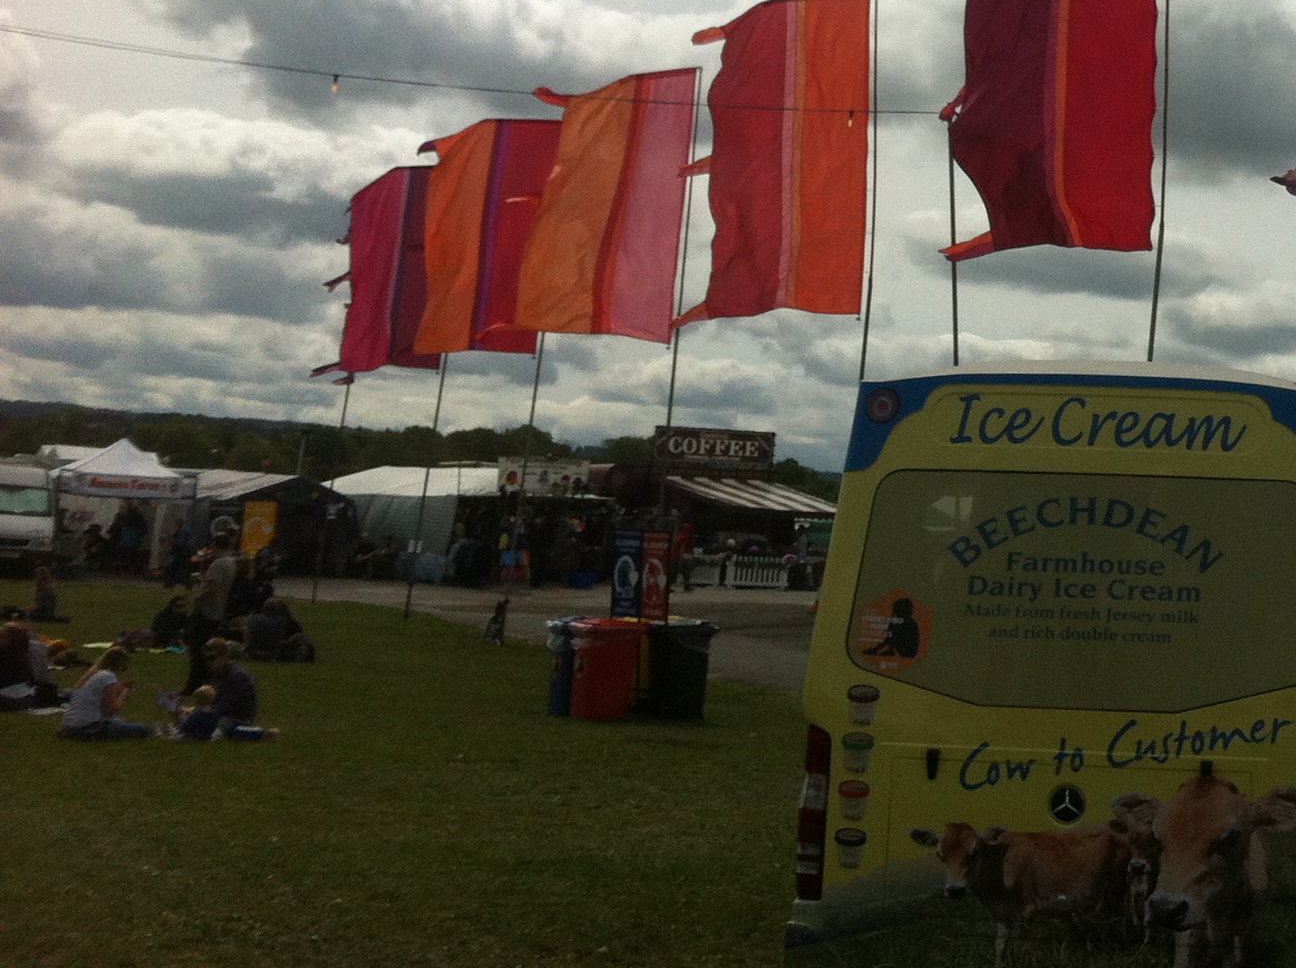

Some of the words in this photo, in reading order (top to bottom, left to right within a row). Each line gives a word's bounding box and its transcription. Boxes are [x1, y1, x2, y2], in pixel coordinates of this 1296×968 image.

[949, 393, 1044, 445] Ice
[1052, 396, 1247, 453] Cream
[667, 435, 760, 459] COFFEE
[948, 496, 1225, 574] BEECHDEAN
[1006, 551, 1166, 577] Farmhouse
[967, 575, 1042, 602] Dairy
[1053, 577, 1097, 599] Ice
[1107, 579, 1201, 602] Cream
[965, 604, 1011, 619] Made
[1016, 604, 1055, 621] from
[1058, 605, 1101, 622] fresh
[1106, 607, 1152, 626] Jersey
[1159, 607, 1200, 625] milk
[987, 624, 1019, 640] and
[1023, 624, 1056, 641] rich
[1060, 626, 1119, 643] double
[1122, 630, 1173, 644] cream
[959, 741, 1036, 790] Cow
[1055, 737, 1085, 776] to
[1107, 719, 1293, 769] Customer
